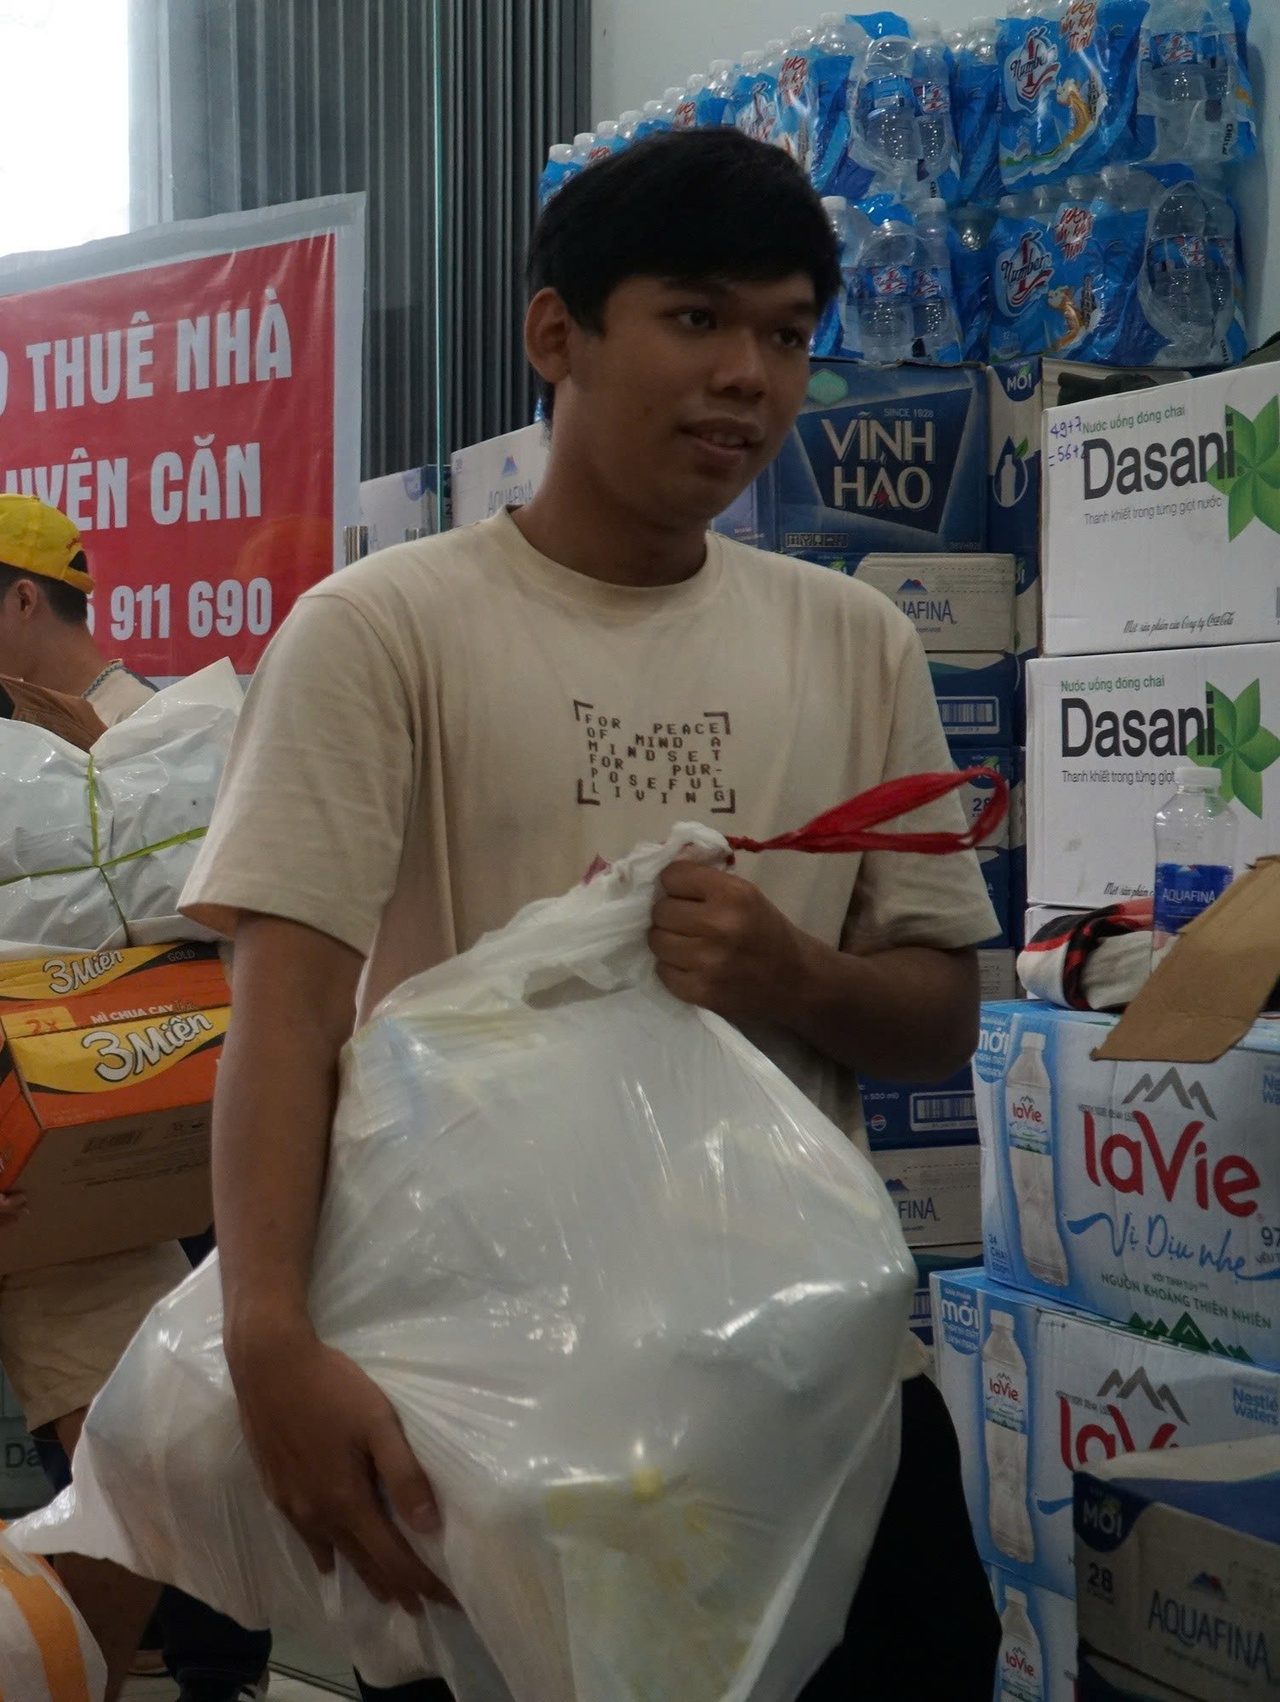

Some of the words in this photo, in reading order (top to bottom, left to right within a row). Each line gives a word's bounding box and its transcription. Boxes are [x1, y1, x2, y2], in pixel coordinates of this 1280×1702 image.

[26, 310, 154, 413] THUÊ
[176, 287, 292, 393] NHÀ
[1165, 405, 1186, 418] chai
[821, 411, 934, 463] VĨNH
[1083, 413, 1238, 500] Dasani
[151, 434, 262, 525] CĂN
[111, 583, 170, 641] 911
[188, 577, 273, 638] 690
[895, 599, 954, 625] UAFINA
[1143, 675, 1166, 688] chai
[585, 713, 621, 729] FOR
[653, 723, 720, 735] PEACE
[1061, 690, 1217, 758] Dasani
[587, 727, 608, 740] OF
[636, 734, 683, 749] MIND
[590, 753, 624, 770] FOR
[1162, 887, 1216, 904] AQUAFINA
[168, 949, 196, 962] GOLD
[109, 1008, 148, 1022] CHUA
[149, 1003, 174, 1016] CAY
[82, 1031, 133, 1083] 3
[1084, 1110, 1261, 1218] laVie
[898, 1197, 937, 1222] FINA
[989, 1377, 1020, 1402] laVie
[1060, 1396, 1180, 1472] laV
[1148, 1588, 1272, 1683] AQUAFINA
